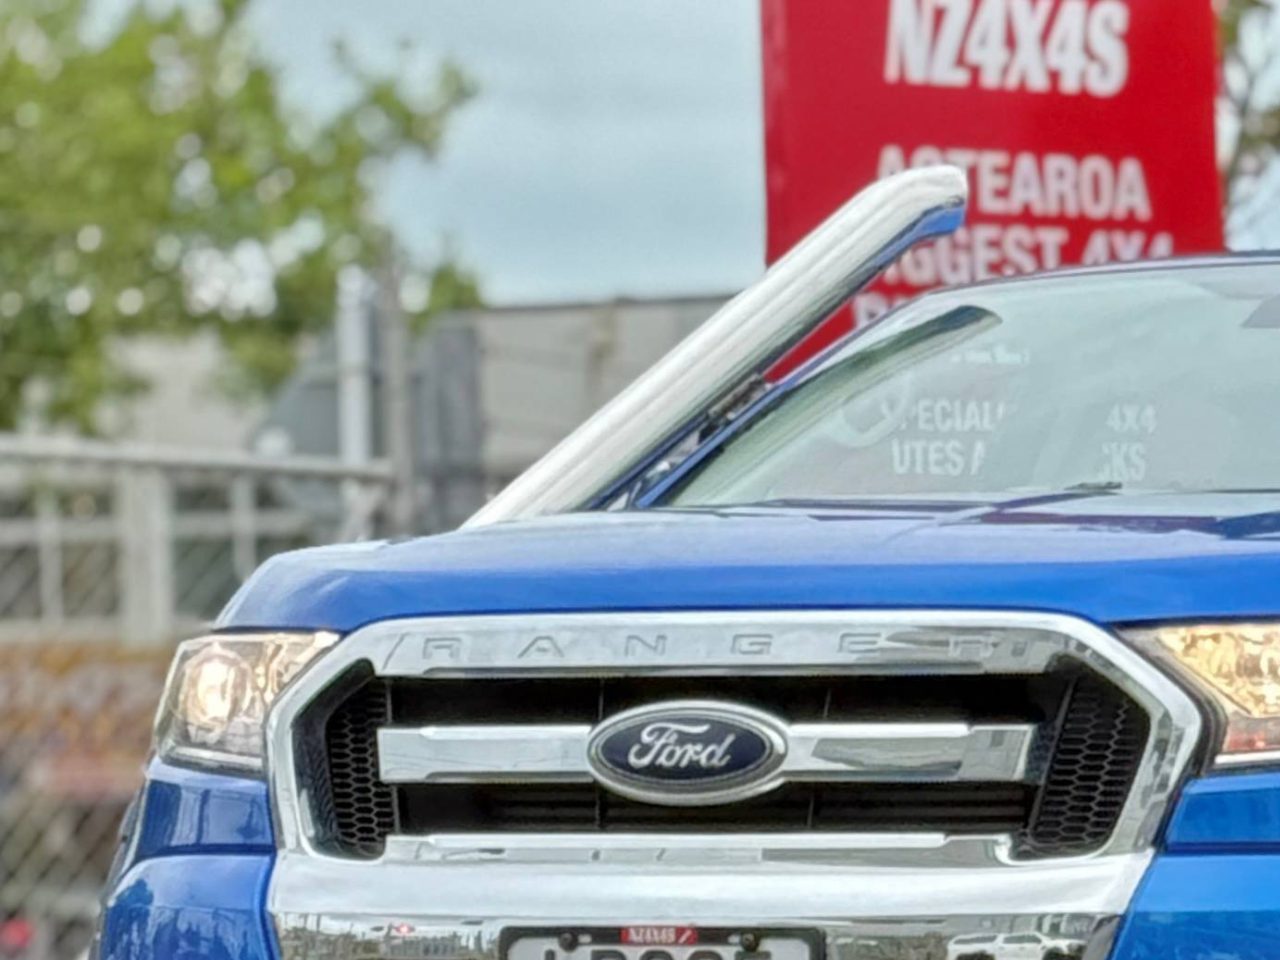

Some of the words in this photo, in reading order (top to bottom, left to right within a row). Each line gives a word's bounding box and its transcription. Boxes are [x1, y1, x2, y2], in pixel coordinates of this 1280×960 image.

[884, 0, 1129, 97] NZ4X4S
[884, 224, 1068, 285] GGEST
[892, 438, 965, 477] UTES
[422, 633, 990, 660] RANGER
[628, 722, 736, 769] Ford
